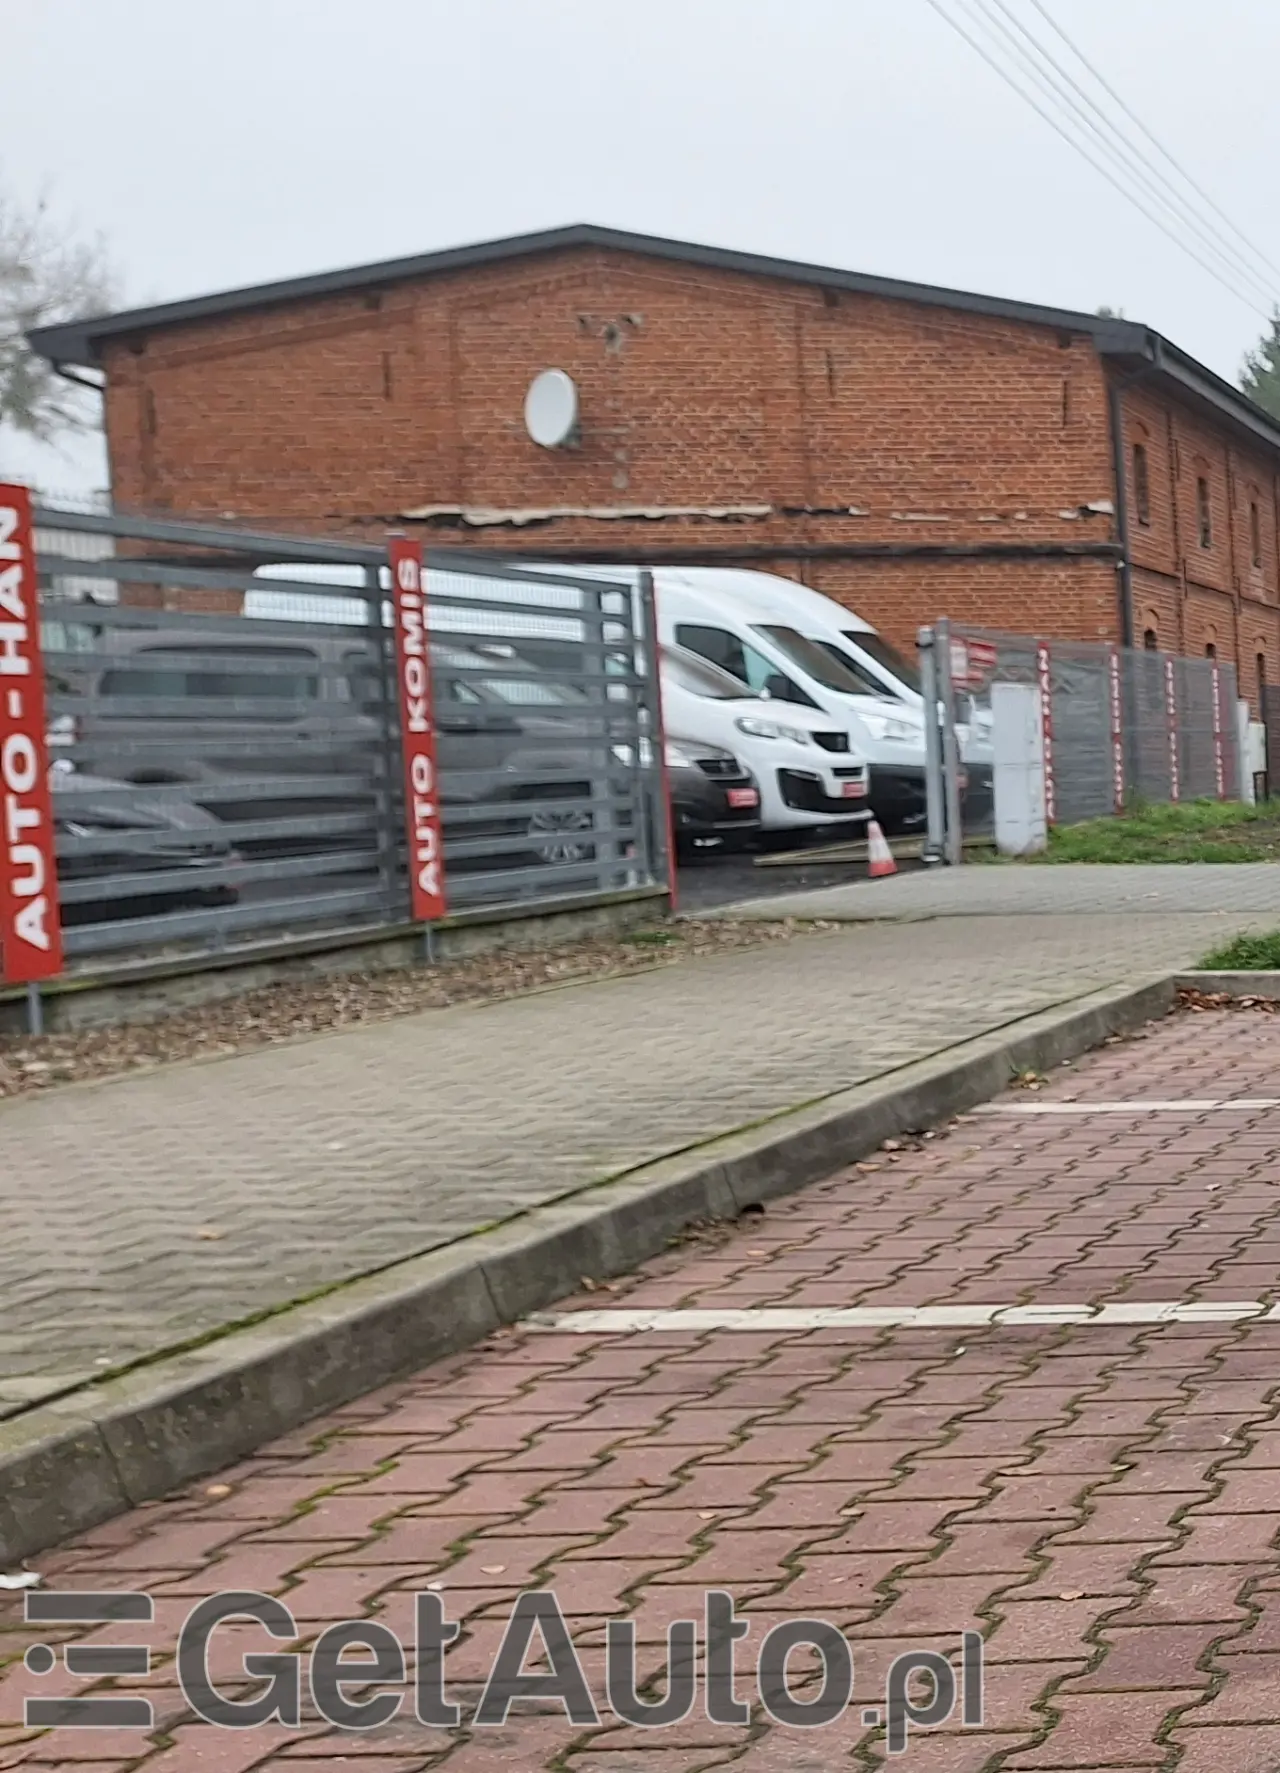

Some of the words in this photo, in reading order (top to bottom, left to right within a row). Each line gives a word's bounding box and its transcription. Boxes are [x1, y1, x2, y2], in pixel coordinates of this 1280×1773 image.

[0, 506, 30, 675] HAN
[397, 557, 430, 733] KOMIS
[1, 733, 51, 952] AUTO
[410, 752, 440, 897] AUTO
